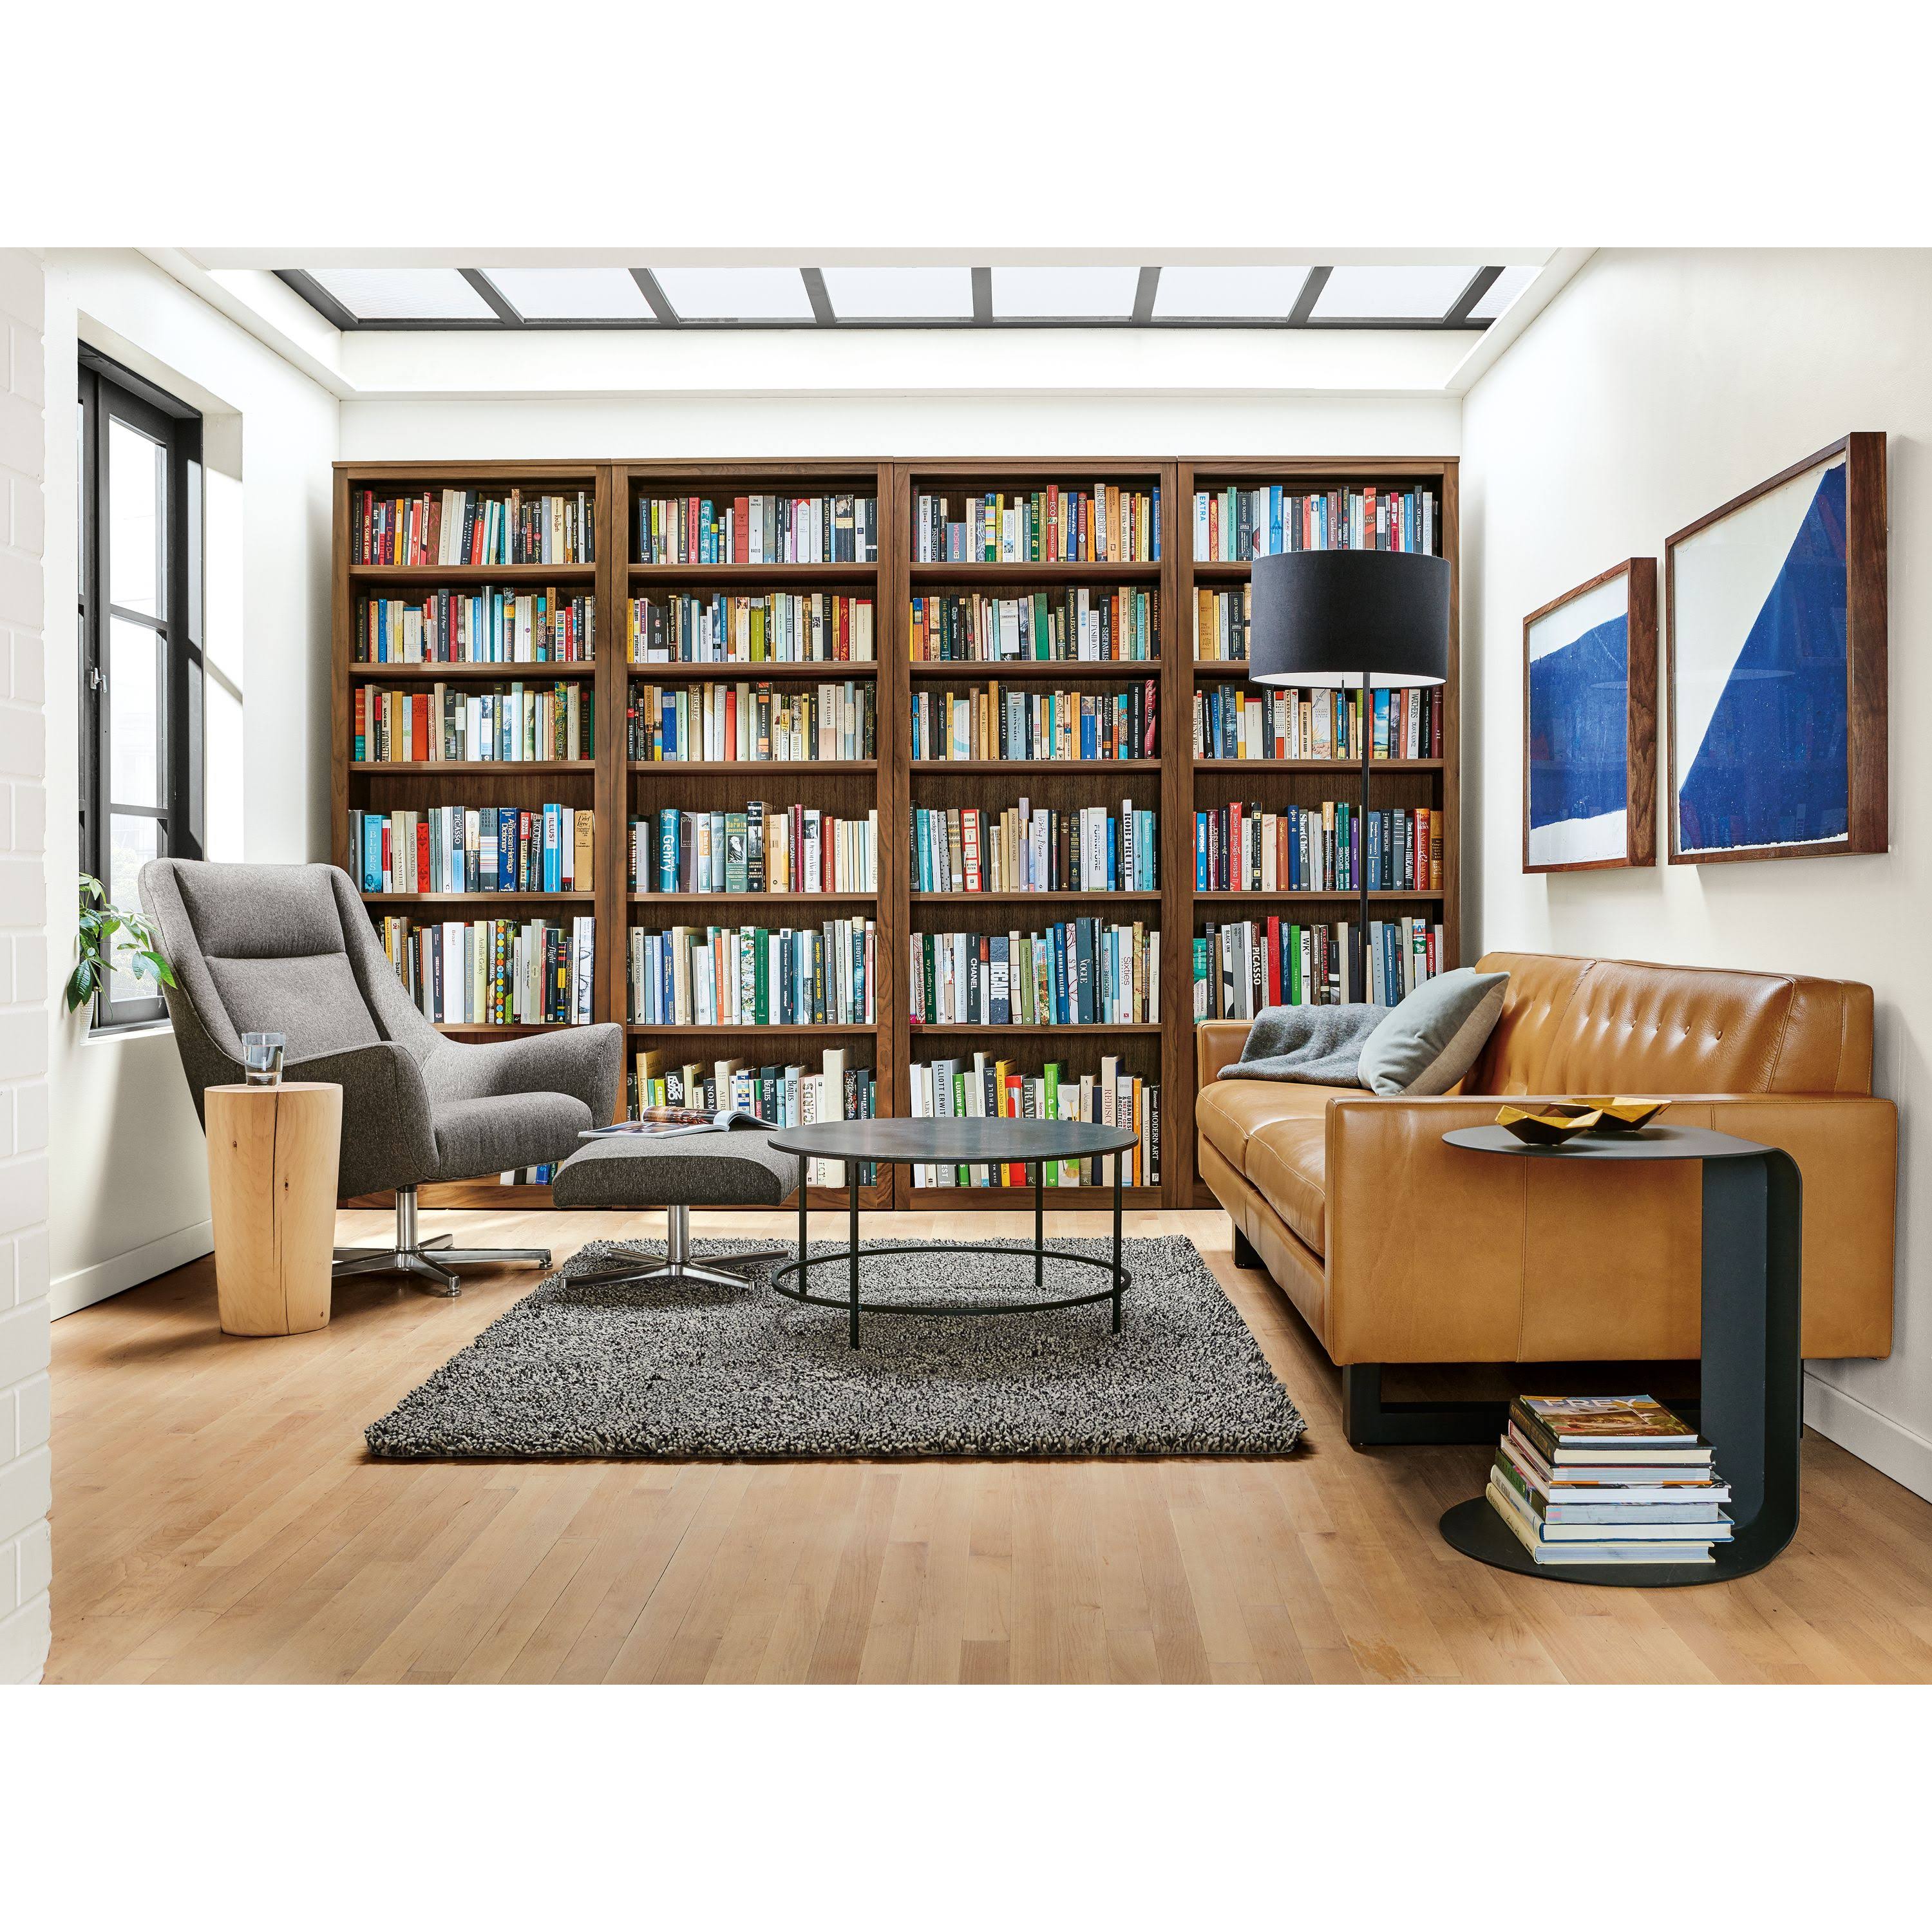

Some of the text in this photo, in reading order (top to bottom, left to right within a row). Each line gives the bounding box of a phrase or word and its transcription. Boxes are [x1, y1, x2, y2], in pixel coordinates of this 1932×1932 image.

[660, 835, 675, 872] Gehry
[547, 945, 556, 963] flight
[476, 958, 484, 975] Gorky
[1079, 959, 1088, 983] VOGUE
[990, 962, 1009, 1000] DECADE
[1013, 973, 1017, 982] WA
[762, 1079, 773, 1101] BEATLES
[787, 1080, 797, 1101] BEATLES
[1544, 1398, 1636, 1407] FREY
